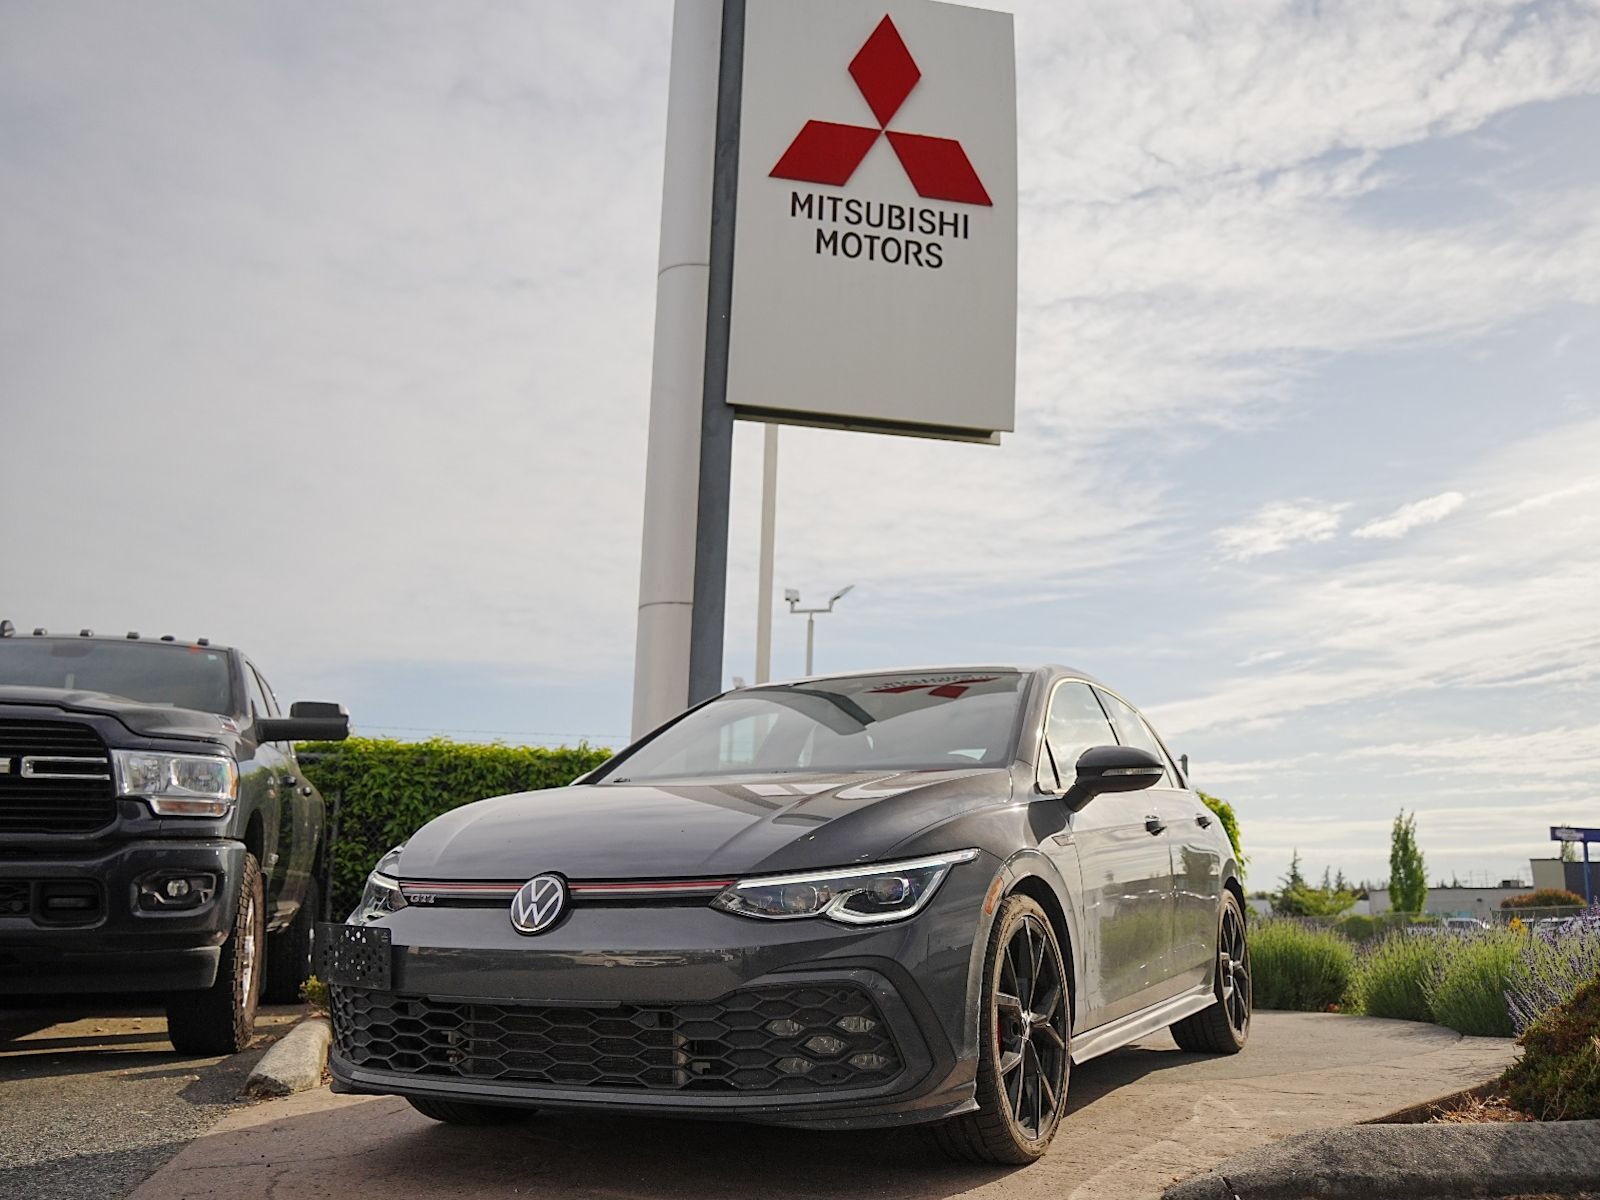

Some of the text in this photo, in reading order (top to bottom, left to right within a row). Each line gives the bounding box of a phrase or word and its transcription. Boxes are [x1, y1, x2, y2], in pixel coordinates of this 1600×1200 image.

[791, 191, 969, 239] MITSUBISHI
[816, 228, 943, 269] MOTORS
[410, 894, 436, 904] GTI
